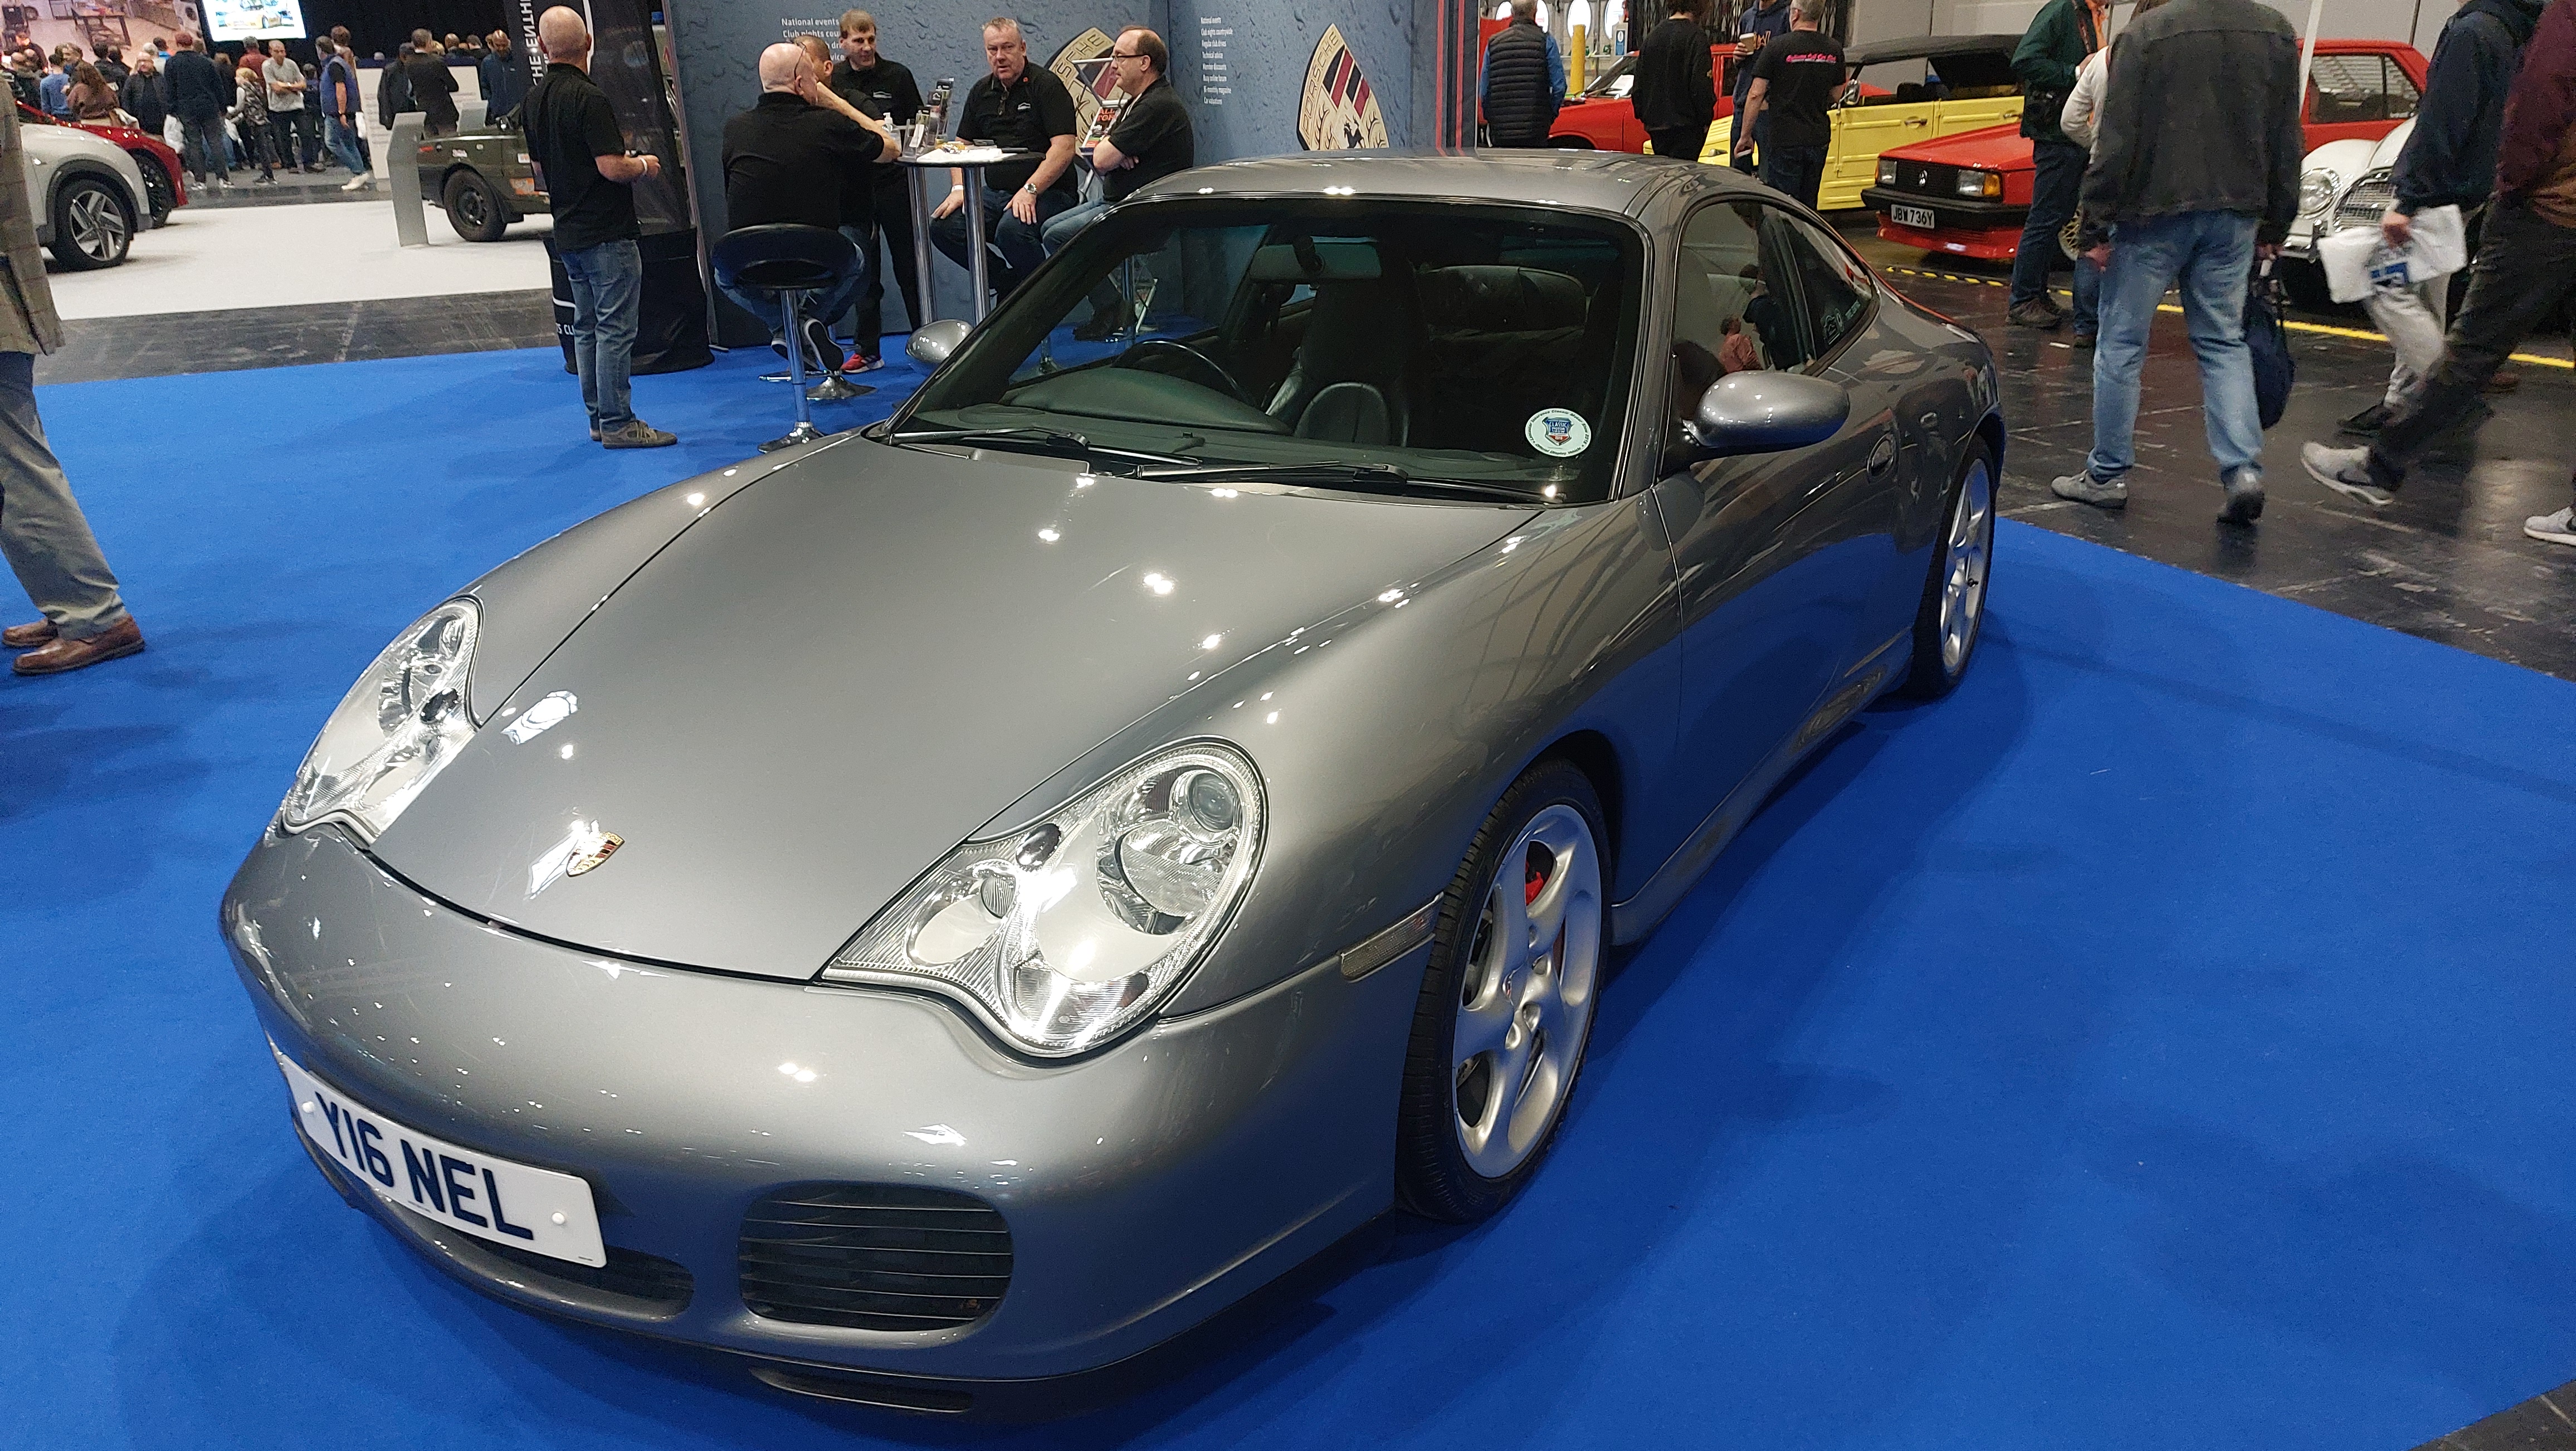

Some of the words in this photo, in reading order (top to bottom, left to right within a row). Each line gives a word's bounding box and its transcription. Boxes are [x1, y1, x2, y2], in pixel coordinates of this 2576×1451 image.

[783, 30, 799, 38] Club
[1056, 34, 1105, 79] SCHE
[1301, 31, 1339, 139] PORSCHE
[1910, 210, 1933, 226] 736Y
[315, 1091, 394, 1188] Y16
[401, 1138, 534, 1241] NEL
